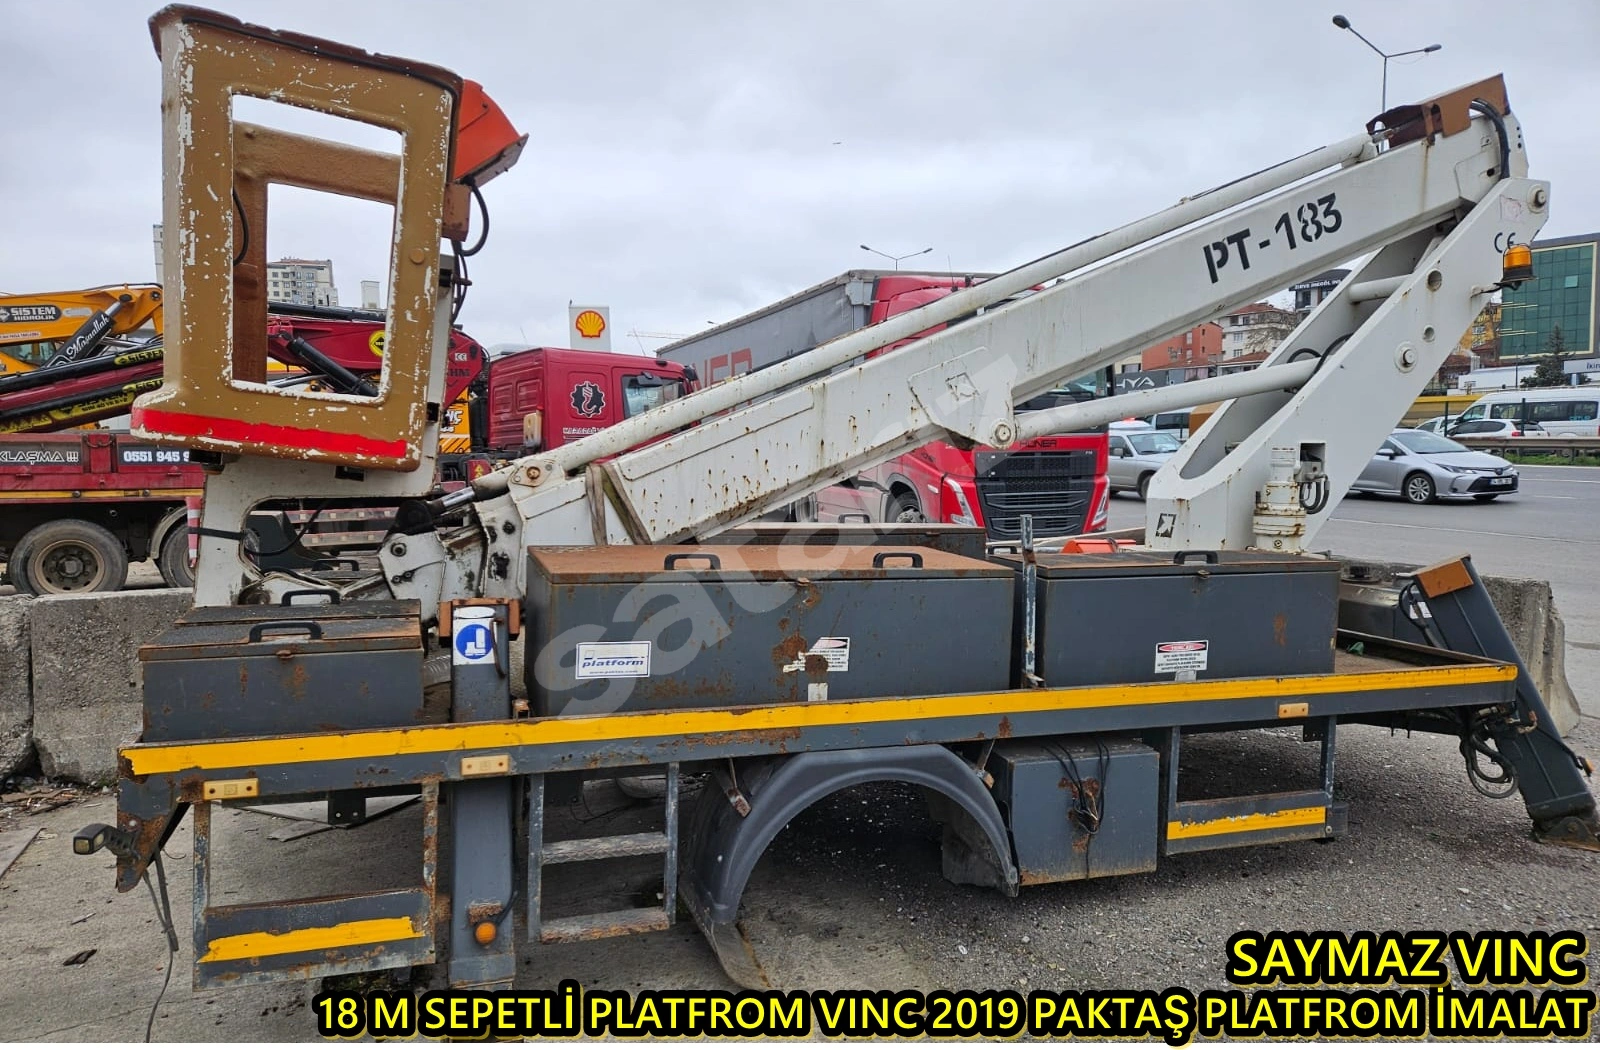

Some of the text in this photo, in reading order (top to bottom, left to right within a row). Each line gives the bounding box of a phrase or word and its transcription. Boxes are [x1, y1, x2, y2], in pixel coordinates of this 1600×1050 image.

[123, 450, 153, 462] 0551
[156, 450, 181, 462] 945
[582, 659, 644, 668] platform
